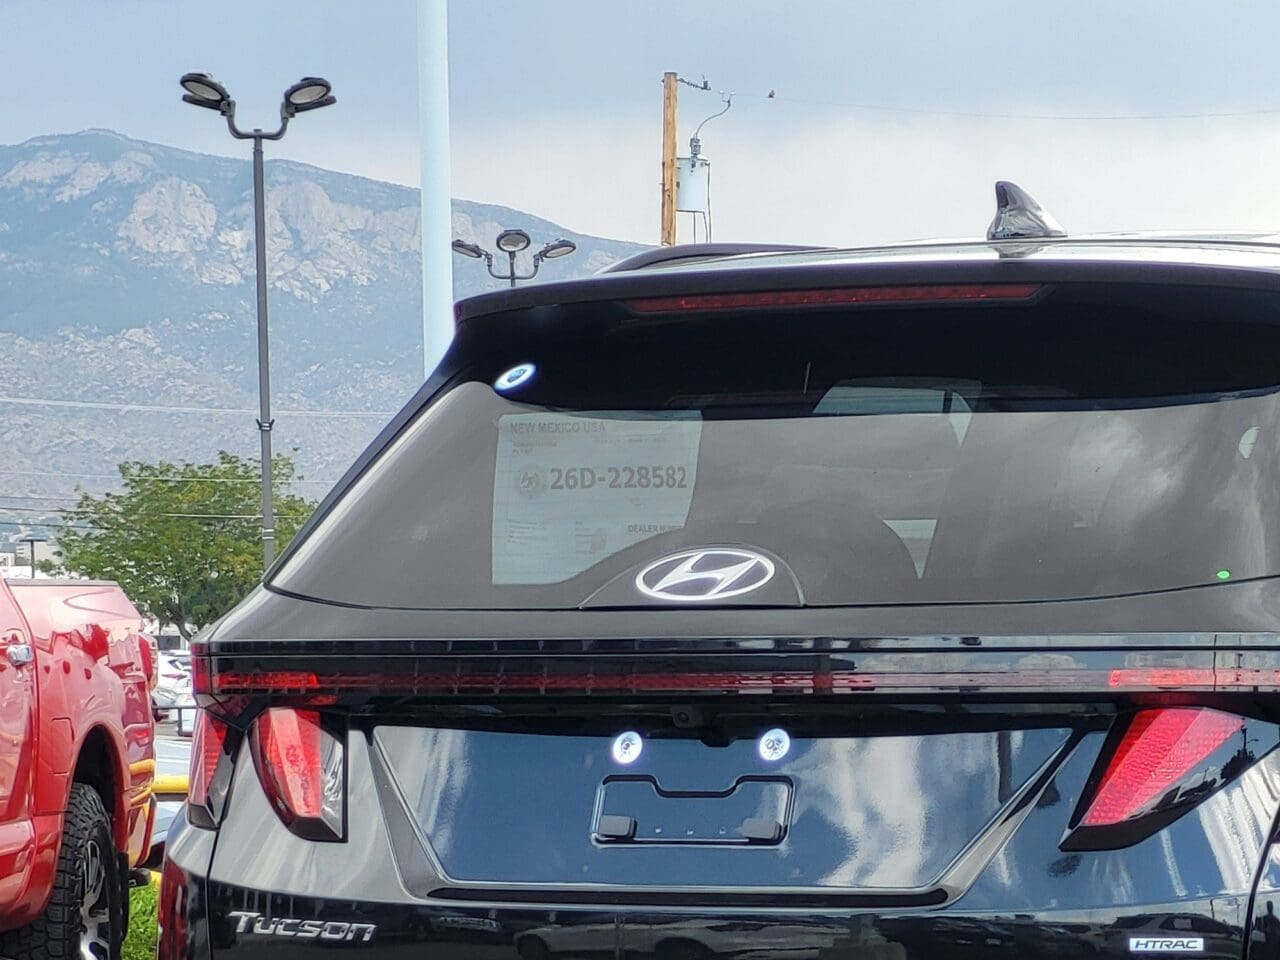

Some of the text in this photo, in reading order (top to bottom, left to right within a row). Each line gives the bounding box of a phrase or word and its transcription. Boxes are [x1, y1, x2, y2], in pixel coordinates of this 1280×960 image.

[510, 421, 606, 433] NEW MEXICO USA
[550, 466, 688, 489] 26D-228582
[627, 525, 659, 533] DEALER
[1135, 940, 1198, 949] HTRAC
